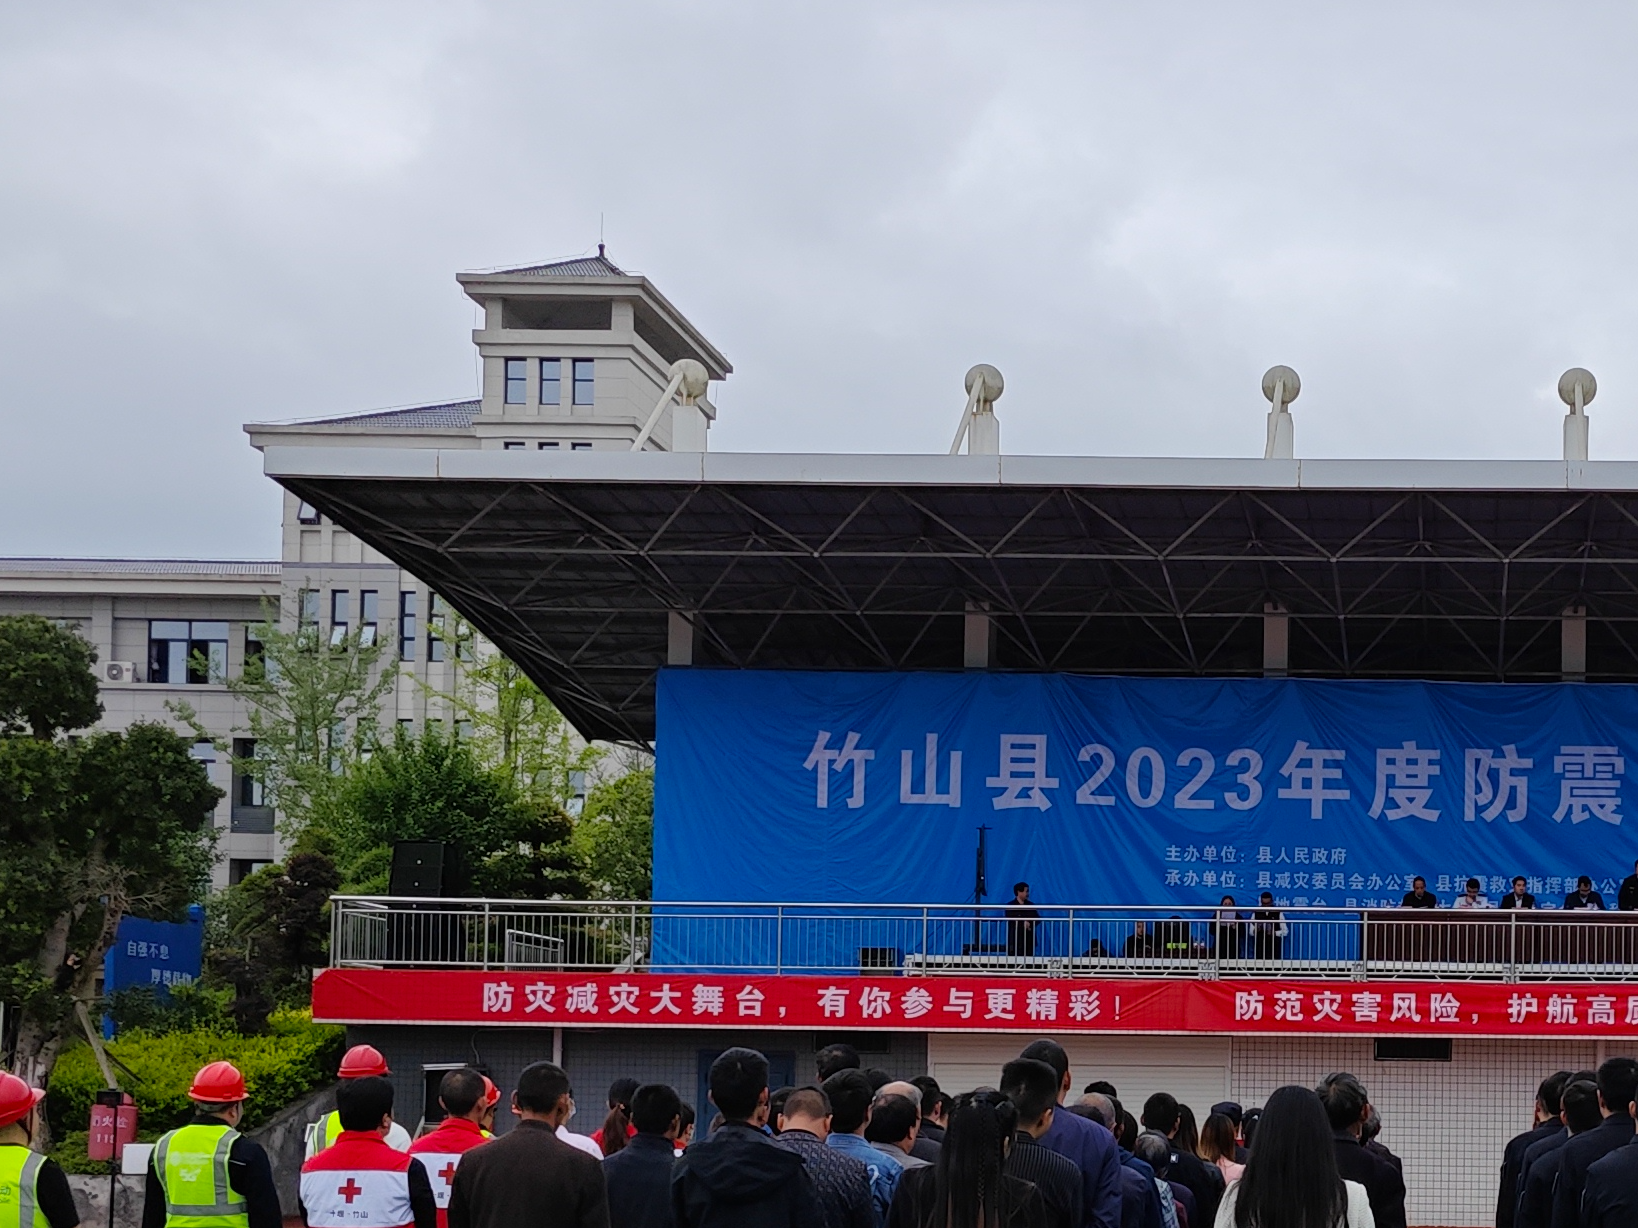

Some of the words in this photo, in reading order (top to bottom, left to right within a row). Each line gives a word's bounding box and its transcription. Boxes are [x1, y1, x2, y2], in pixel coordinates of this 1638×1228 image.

[1256, 846, 1347, 865] 县人民政府
